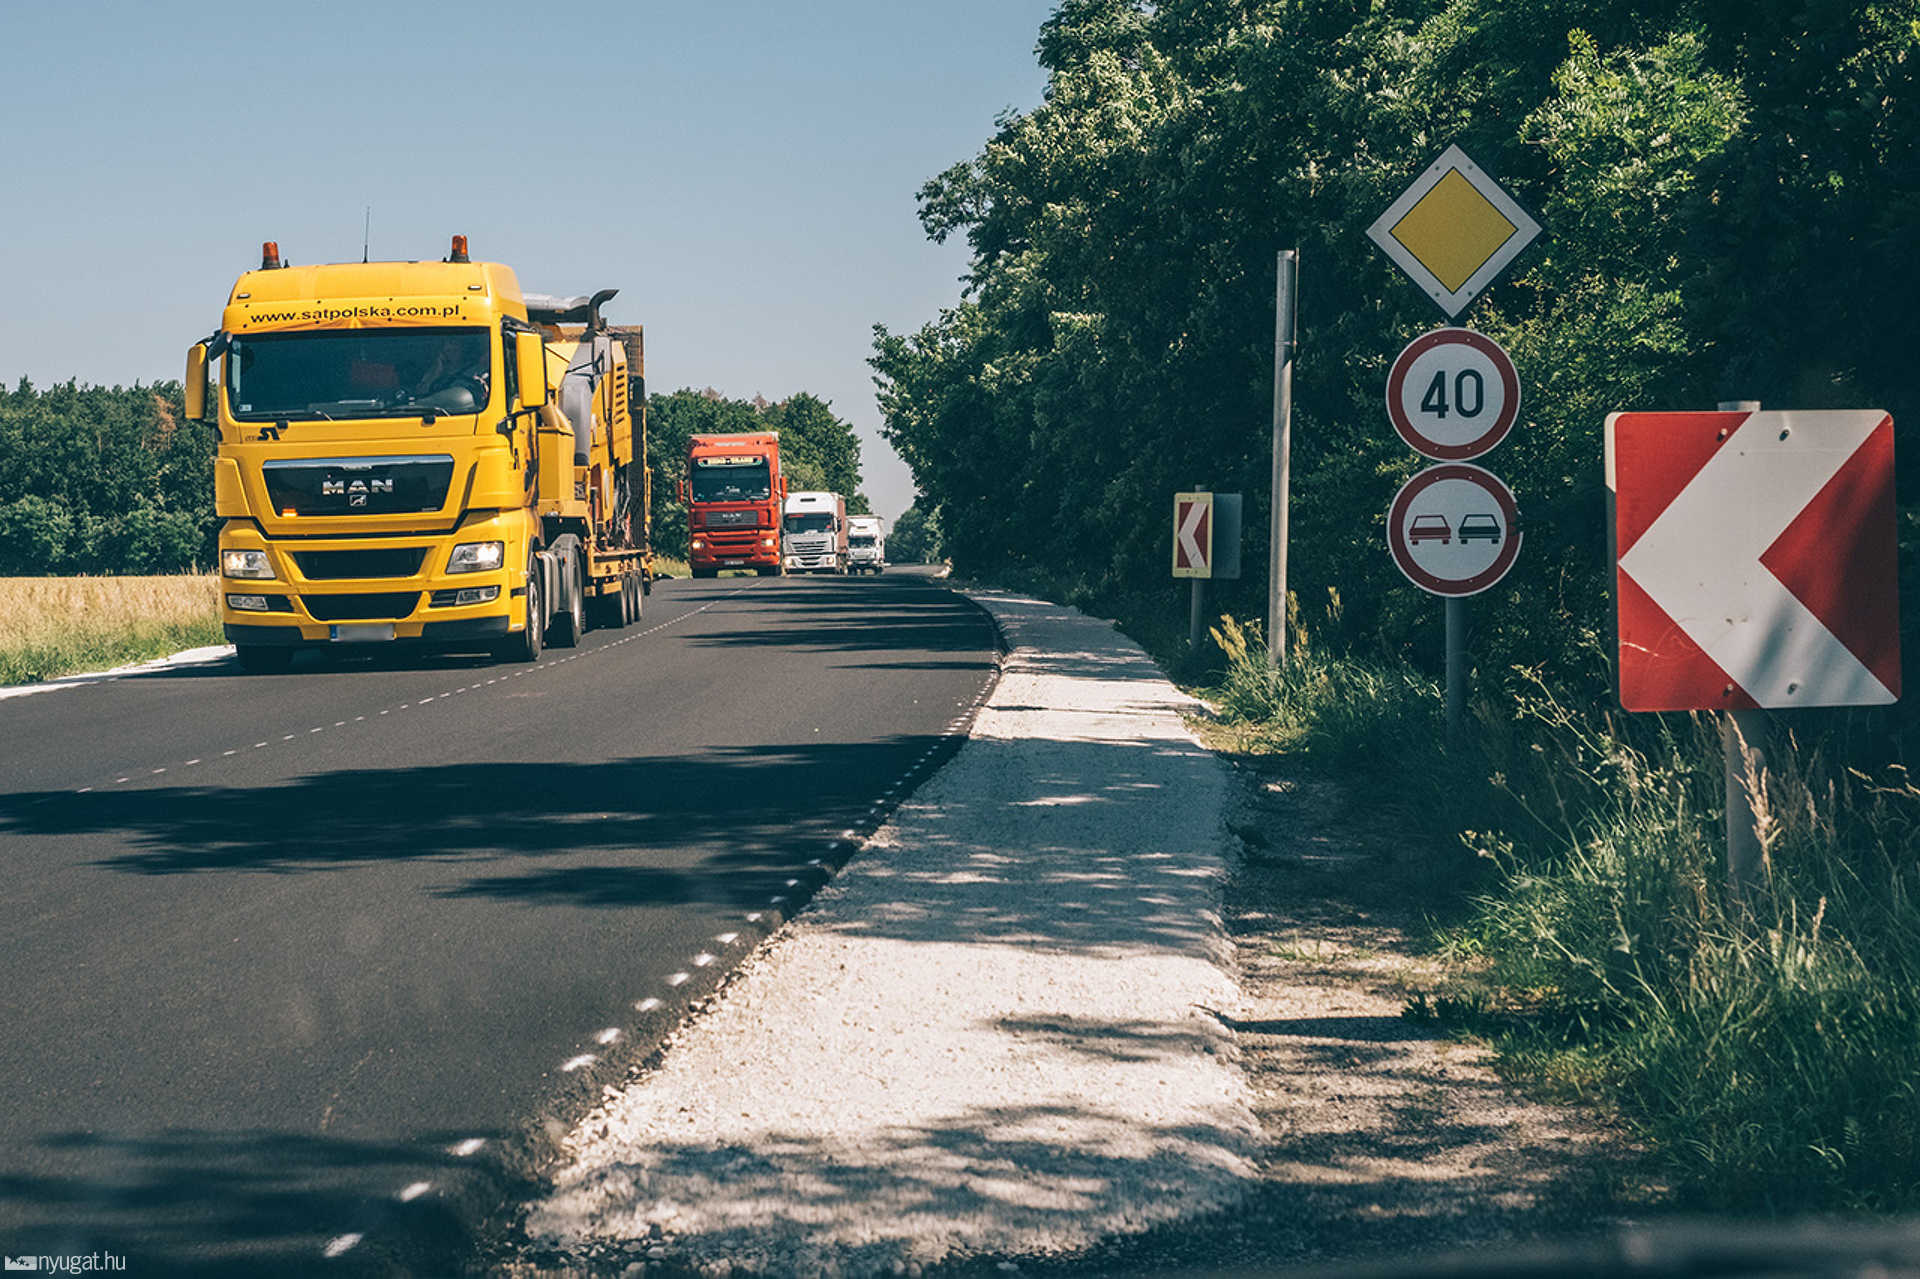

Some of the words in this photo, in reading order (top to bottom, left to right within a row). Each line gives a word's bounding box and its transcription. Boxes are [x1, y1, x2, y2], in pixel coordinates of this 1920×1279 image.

[250, 305, 459, 323] www.satpolska.com.pl
[1421, 368, 1484, 419] 40
[322, 479, 393, 495] MAN
